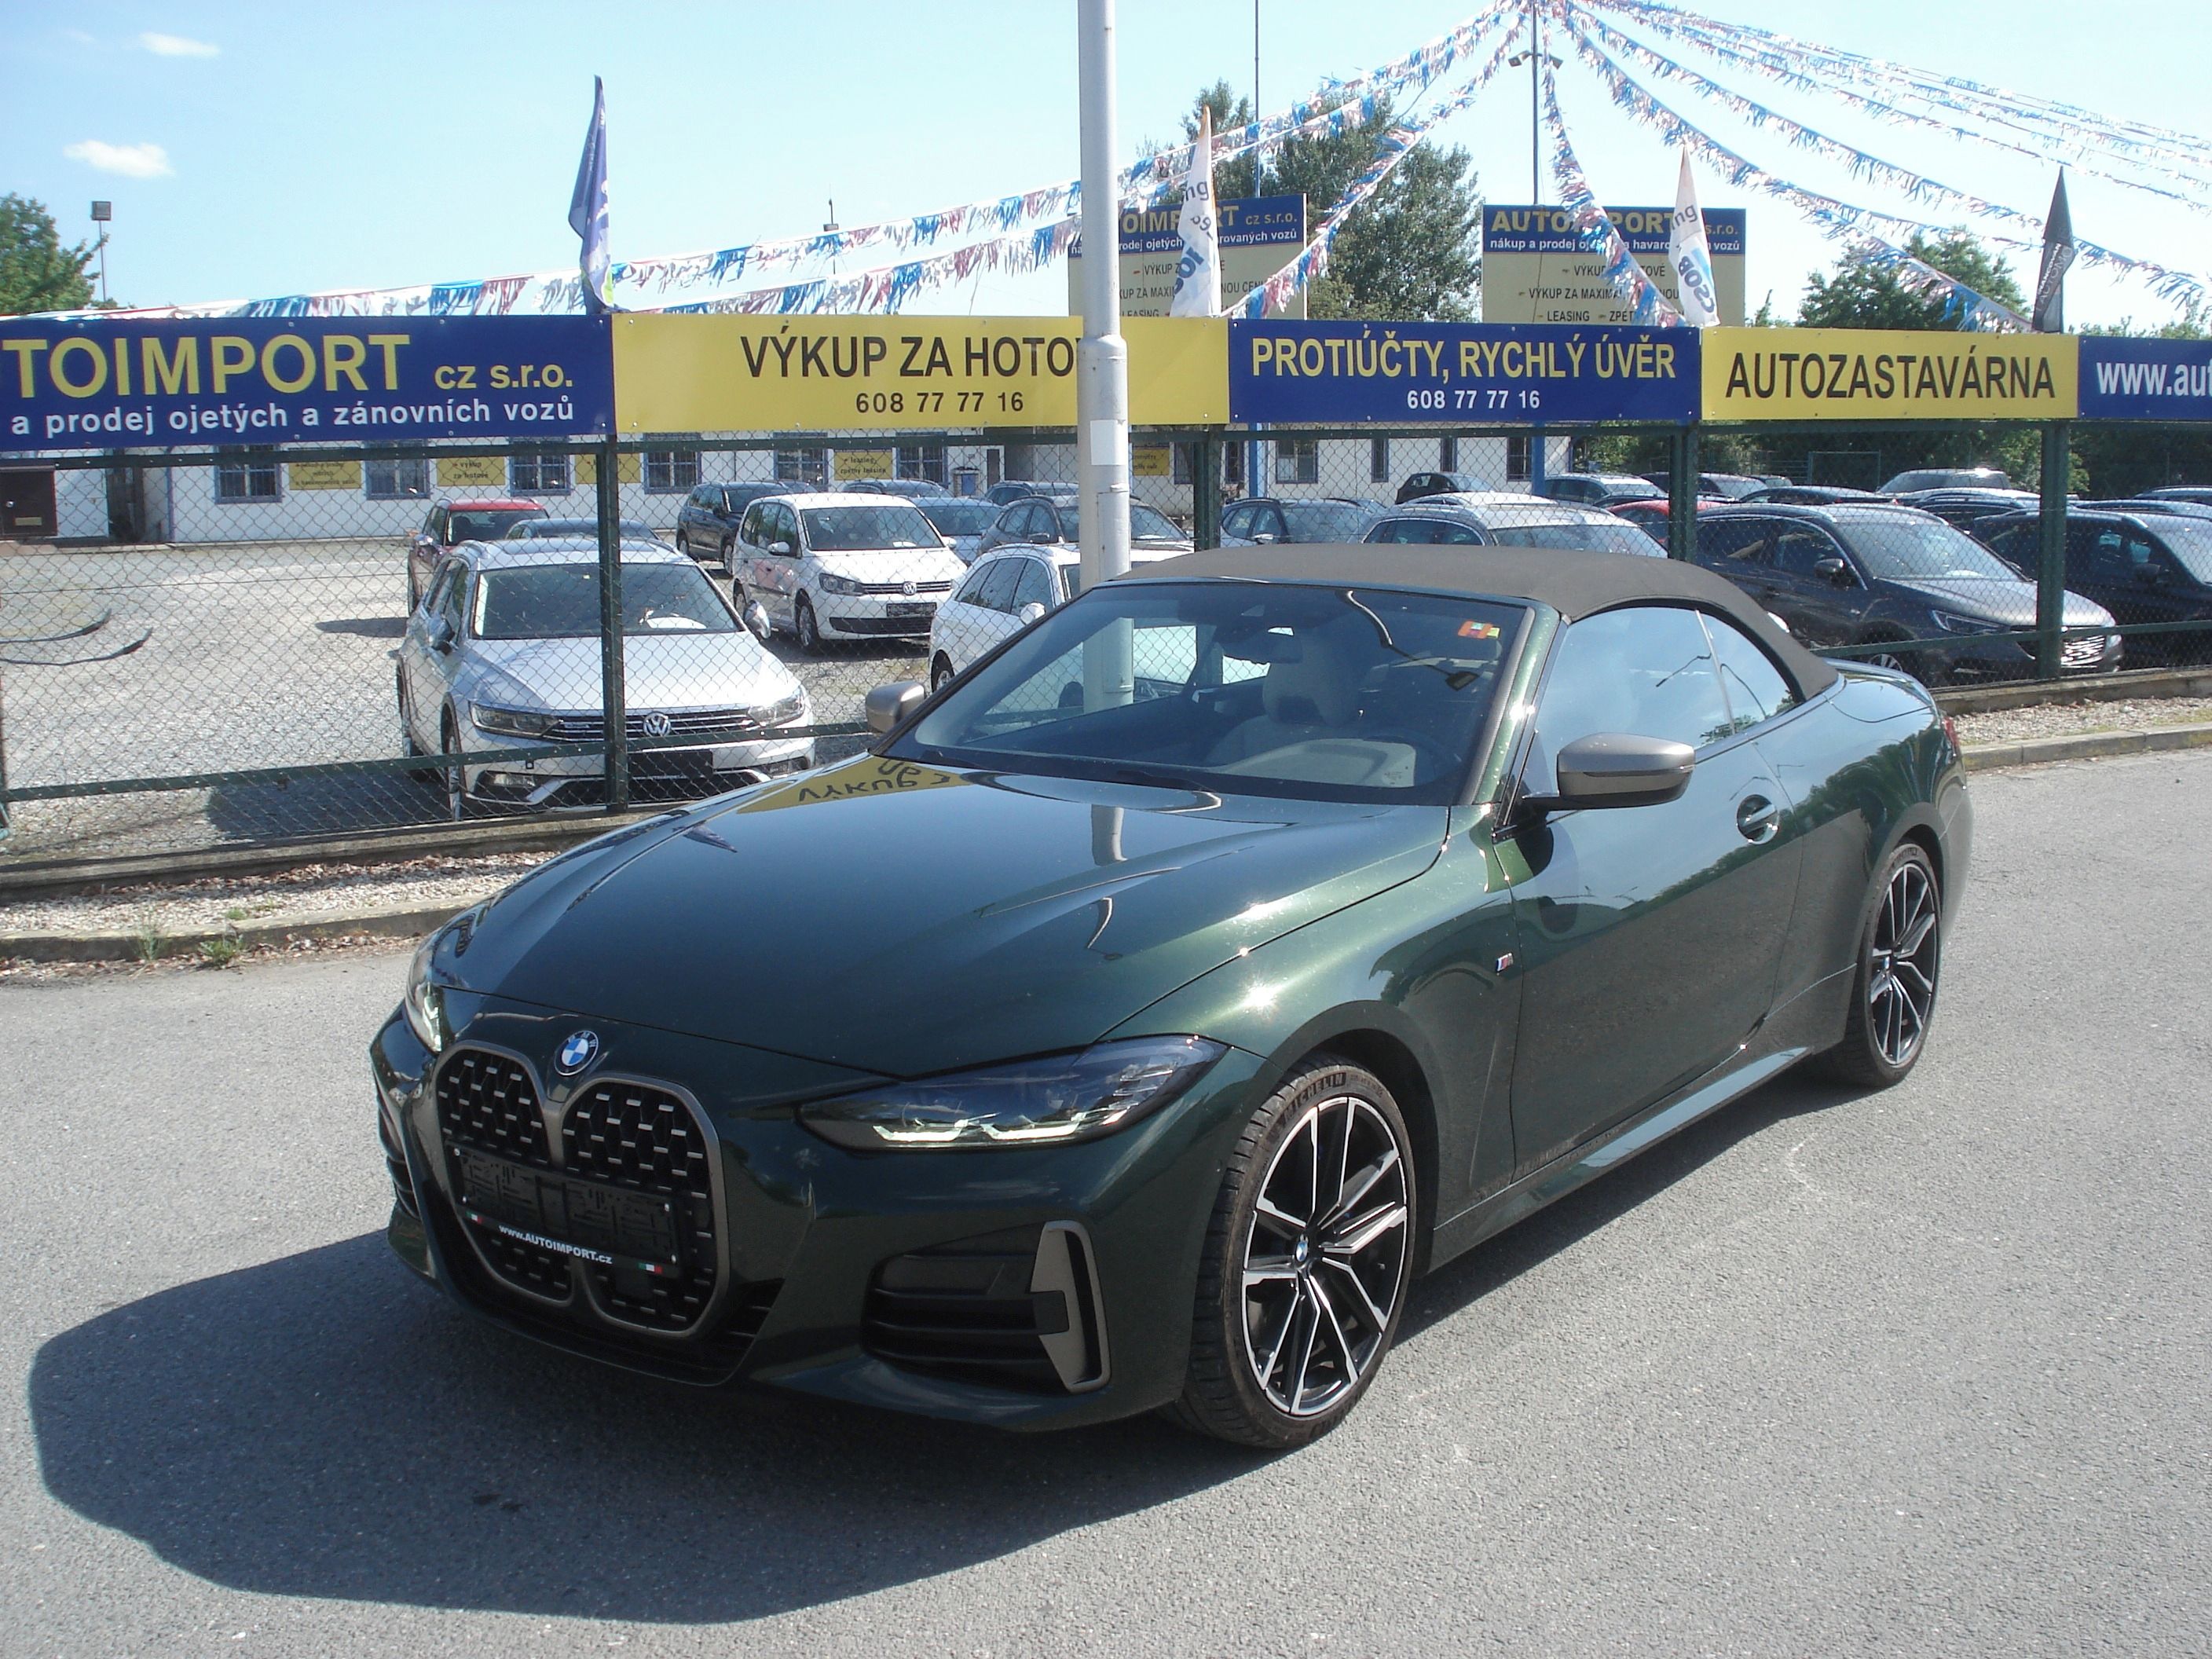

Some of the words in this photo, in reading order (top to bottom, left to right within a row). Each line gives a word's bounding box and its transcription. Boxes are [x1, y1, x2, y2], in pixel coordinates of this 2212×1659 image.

[1246, 215, 1260, 225] cz
[1265, 213, 1298, 224] s.r.o.
[1119, 240, 1143, 251] rodej
[1146, 237, 1182, 251] ojetých
[1271, 229, 1297, 240] vozů
[1490, 238, 1525, 250] nákup
[1540, 239, 1575, 251] prodej
[1137, 287, 1148, 298] ZA
[1565, 287, 1578, 299] ZA
[1547, 310, 1590, 321] LEASING
[740, 325, 887, 378] VÝKUP
[899, 336, 953, 377] ZA
[965, 335, 1081, 378] HOTO
[1251, 330, 1449, 384] PROTIÚČTY,
[1459, 332, 1588, 379] RYCHLÝ
[1596, 333, 1675, 379] ÚVĚR
[2, 334, 410, 398] TOIMPORT
[434, 365, 477, 390] cz
[490, 364, 573, 389] s.r.o.
[1726, 346, 2056, 399] AUTOZASTAVÁRNA
[855, 393, 904, 413] 608
[917, 393, 944, 412] 77
[957, 393, 984, 412] 77
[998, 392, 1024, 412] 16
[1407, 390, 1445, 410] 608
[1455, 390, 1477, 409] 77
[1486, 390, 1509, 409] 77
[1518, 390, 1540, 409] 16
[11, 416, 30, 434] a
[46, 406, 153, 438] prodej
[169, 402, 287, 434] ojetých
[302, 407, 319, 427] a
[334, 398, 489, 426] zánovních
[504, 395, 573, 420] vozů
[498, 1225, 613, 1265] www.AUTOIMPORT.cz
